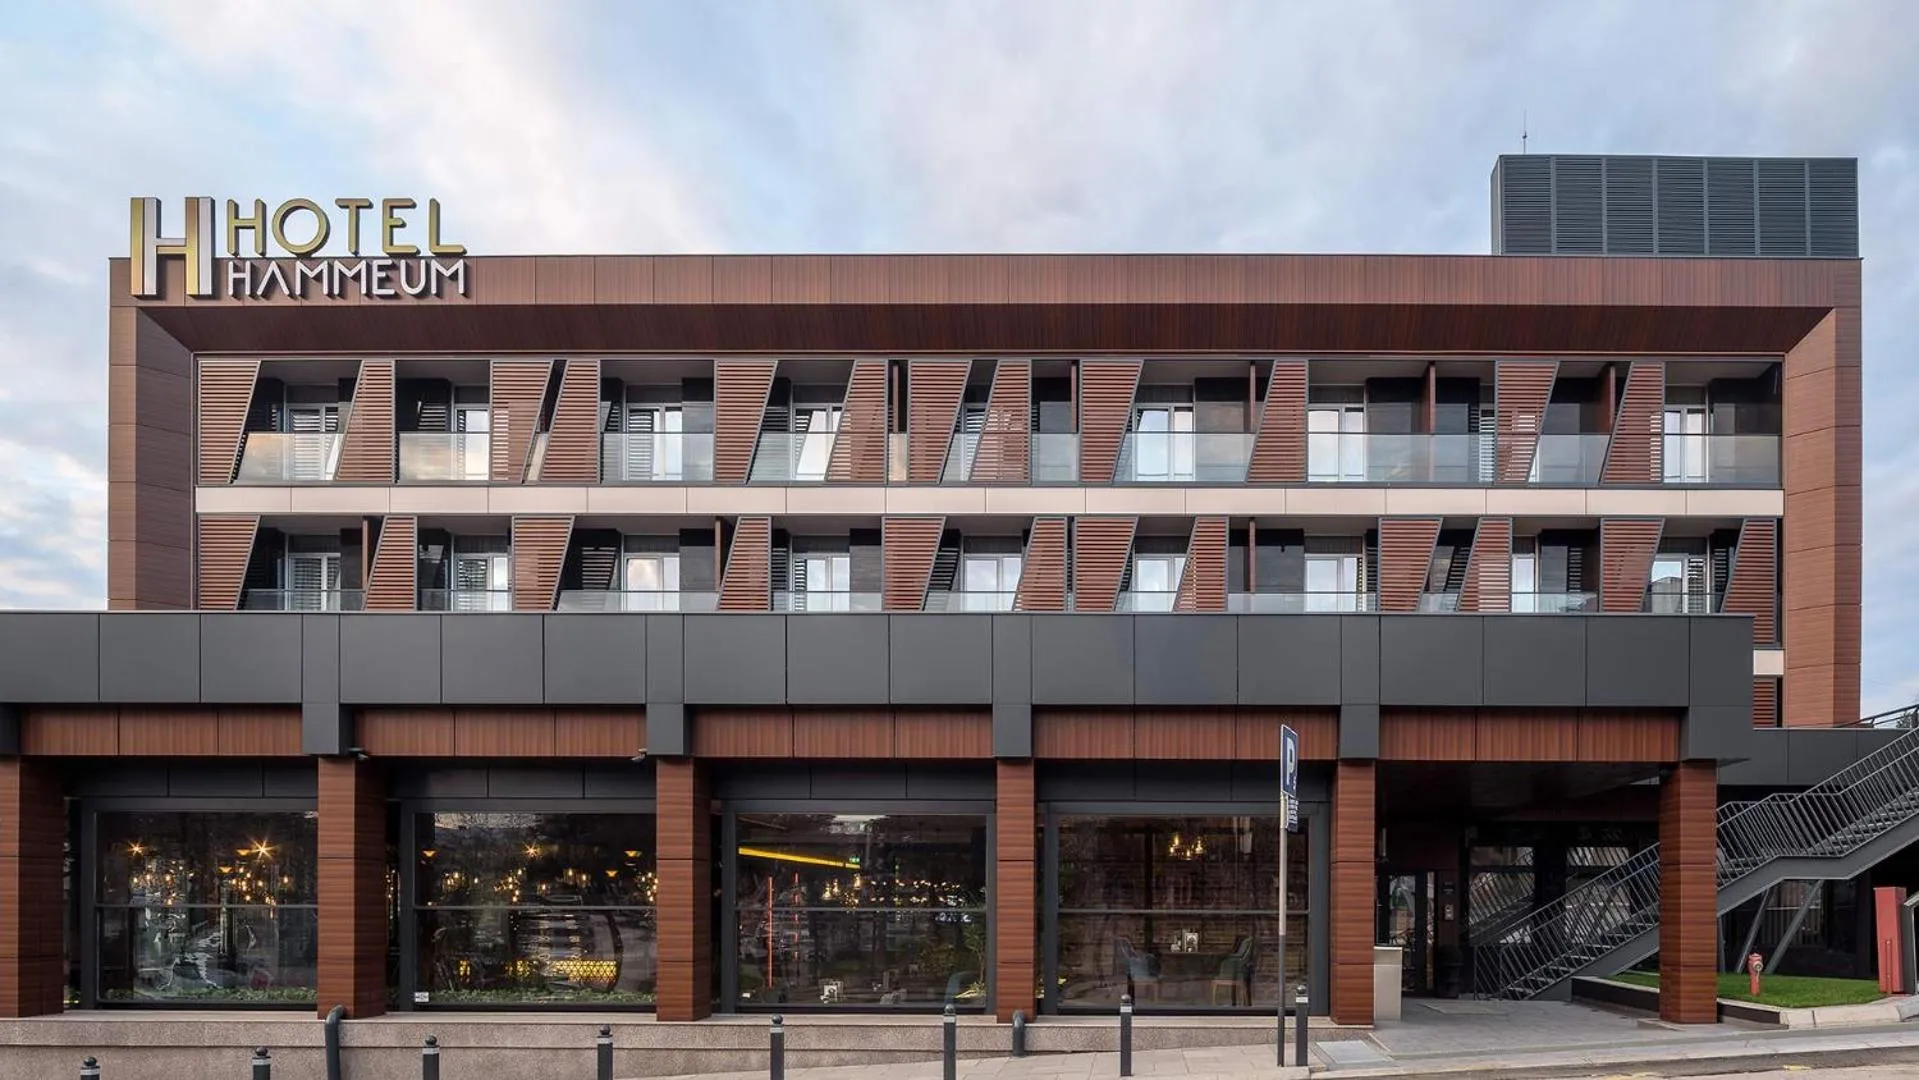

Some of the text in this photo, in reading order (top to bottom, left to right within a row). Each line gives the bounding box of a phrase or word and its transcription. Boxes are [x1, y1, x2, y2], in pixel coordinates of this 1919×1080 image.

[130, 197, 215, 297] H
[227, 198, 467, 256] HOTEL
[228, 259, 467, 297] HAMMEUM
[1286, 737, 1296, 786] P
